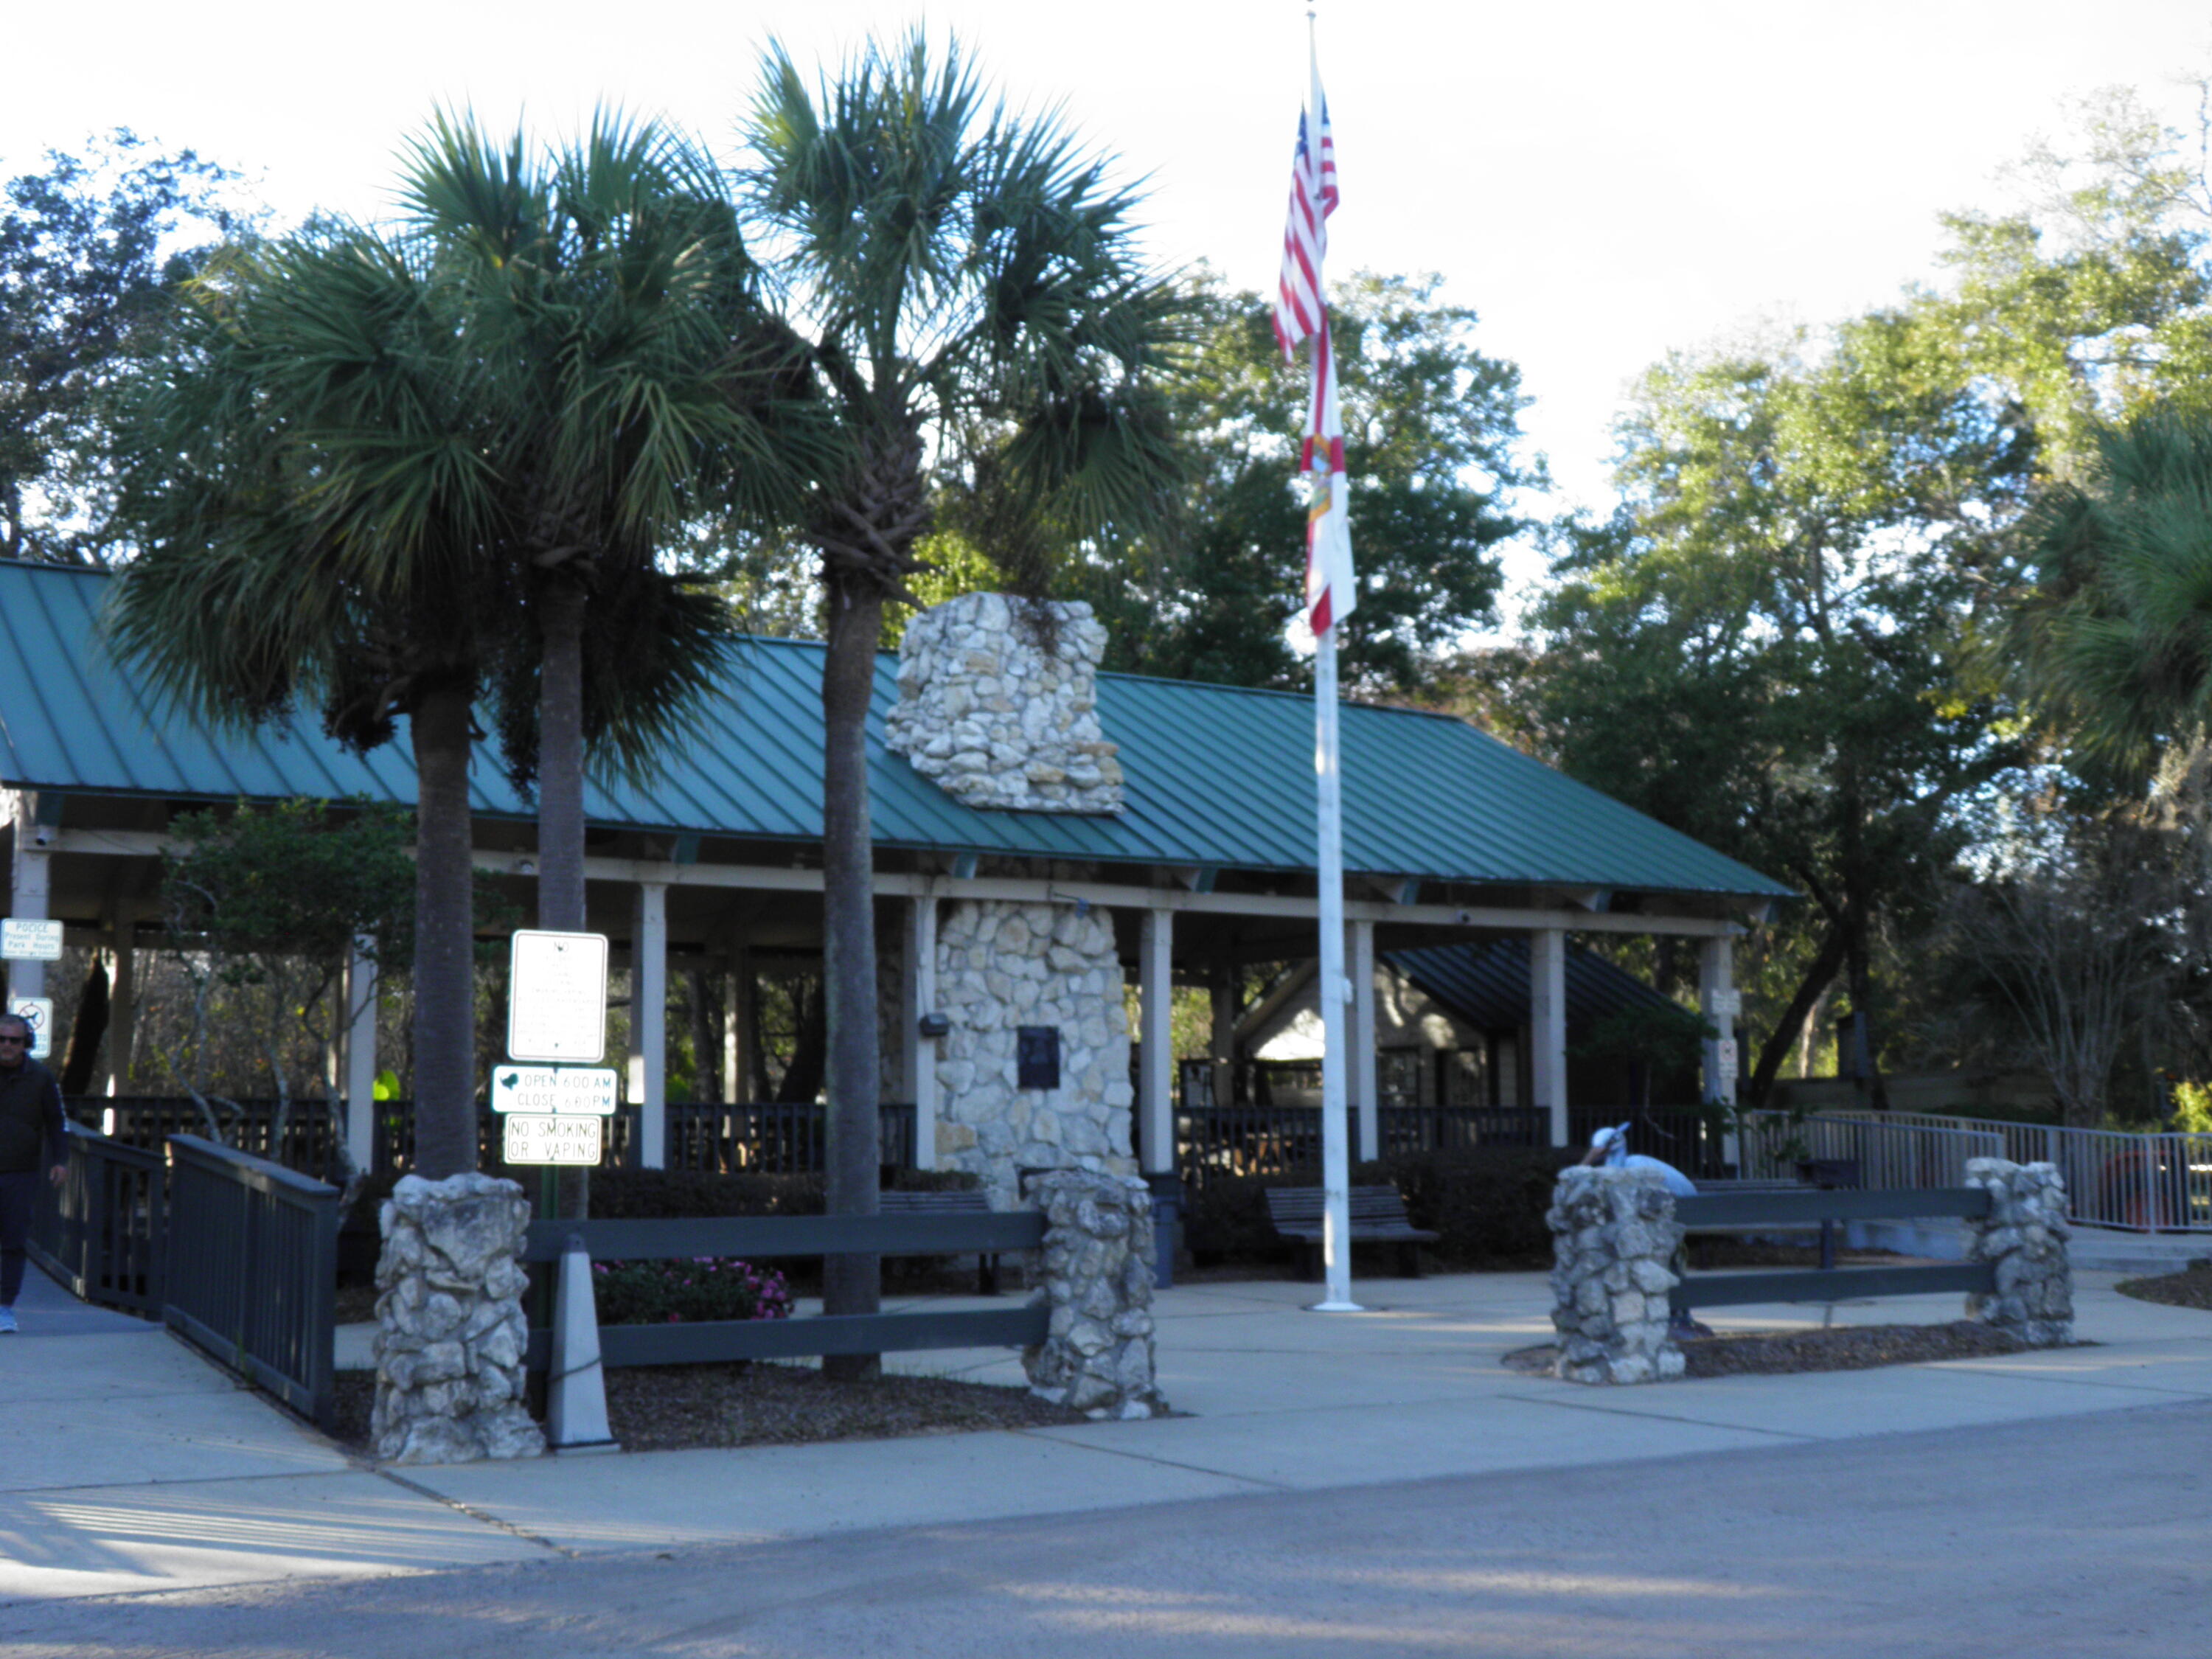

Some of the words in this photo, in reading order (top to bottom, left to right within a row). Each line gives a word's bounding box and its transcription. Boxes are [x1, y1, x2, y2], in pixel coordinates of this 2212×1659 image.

[16, 922, 47, 933] POLICE
[9, 940, 25, 948] Park
[553, 941, 569, 953] NO
[524, 1074, 557, 1087] OPEN
[594, 1077, 611, 1089] AM
[518, 1093, 556, 1106] CLOSE
[593, 1095, 611, 1108] PM
[511, 1121, 529, 1136] NO
[538, 1121, 596, 1138] SMOKING
[511, 1141, 528, 1157] OR
[545, 1142, 595, 1158] VAPING
